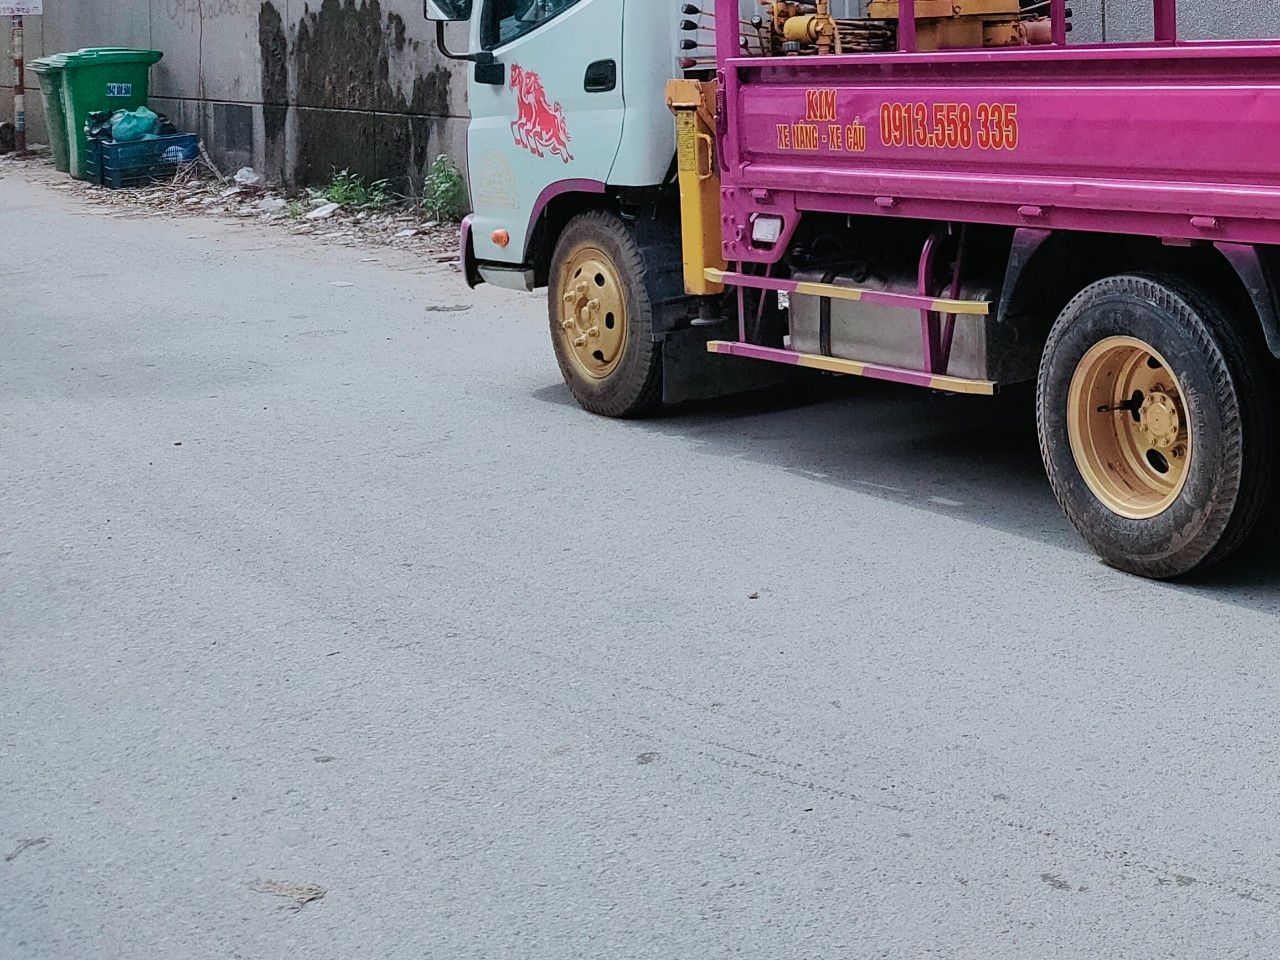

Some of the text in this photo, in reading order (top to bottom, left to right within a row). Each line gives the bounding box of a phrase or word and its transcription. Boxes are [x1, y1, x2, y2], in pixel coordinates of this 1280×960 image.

[805, 89, 837, 121] KIM
[776, 123, 790, 149] XE
[792, 119, 819, 150] NÂNG
[828, 125, 842, 151] XE
[879, 101, 1019, 151] 0913.558 335
